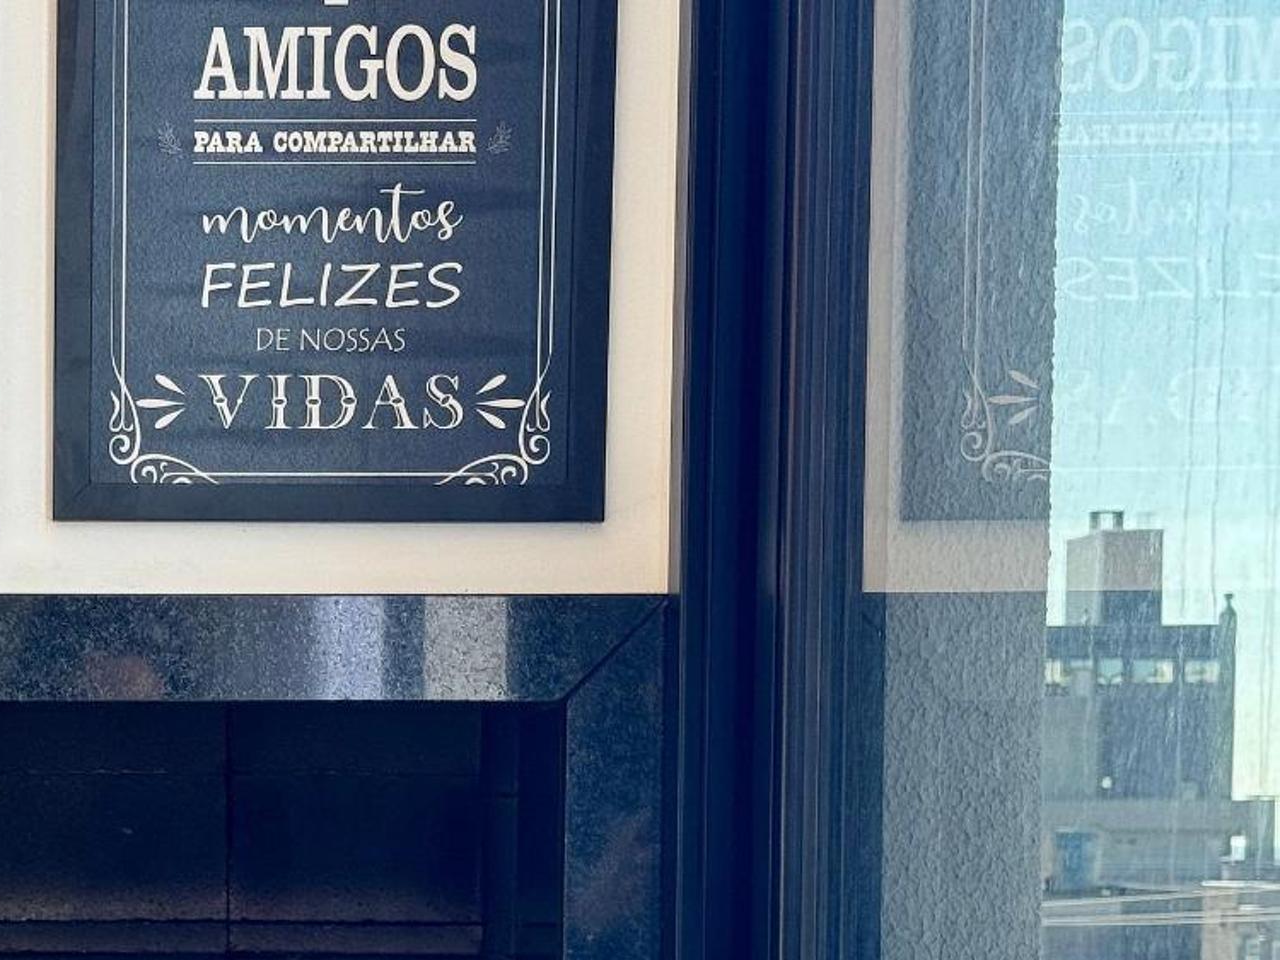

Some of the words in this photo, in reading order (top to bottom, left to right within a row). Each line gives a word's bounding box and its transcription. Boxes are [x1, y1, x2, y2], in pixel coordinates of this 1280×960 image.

[193, 23, 477, 102] AMIGOS
[193, 131, 263, 154] PARA
[273, 130, 477, 154] COMPARTILHAR
[202, 182, 464, 244] momentos
[201, 262, 463, 308] FELIZES
[256, 327, 291, 352] DE
[299, 327, 406, 353] NOSSAS
[197, 374, 465, 430] VIDAS
